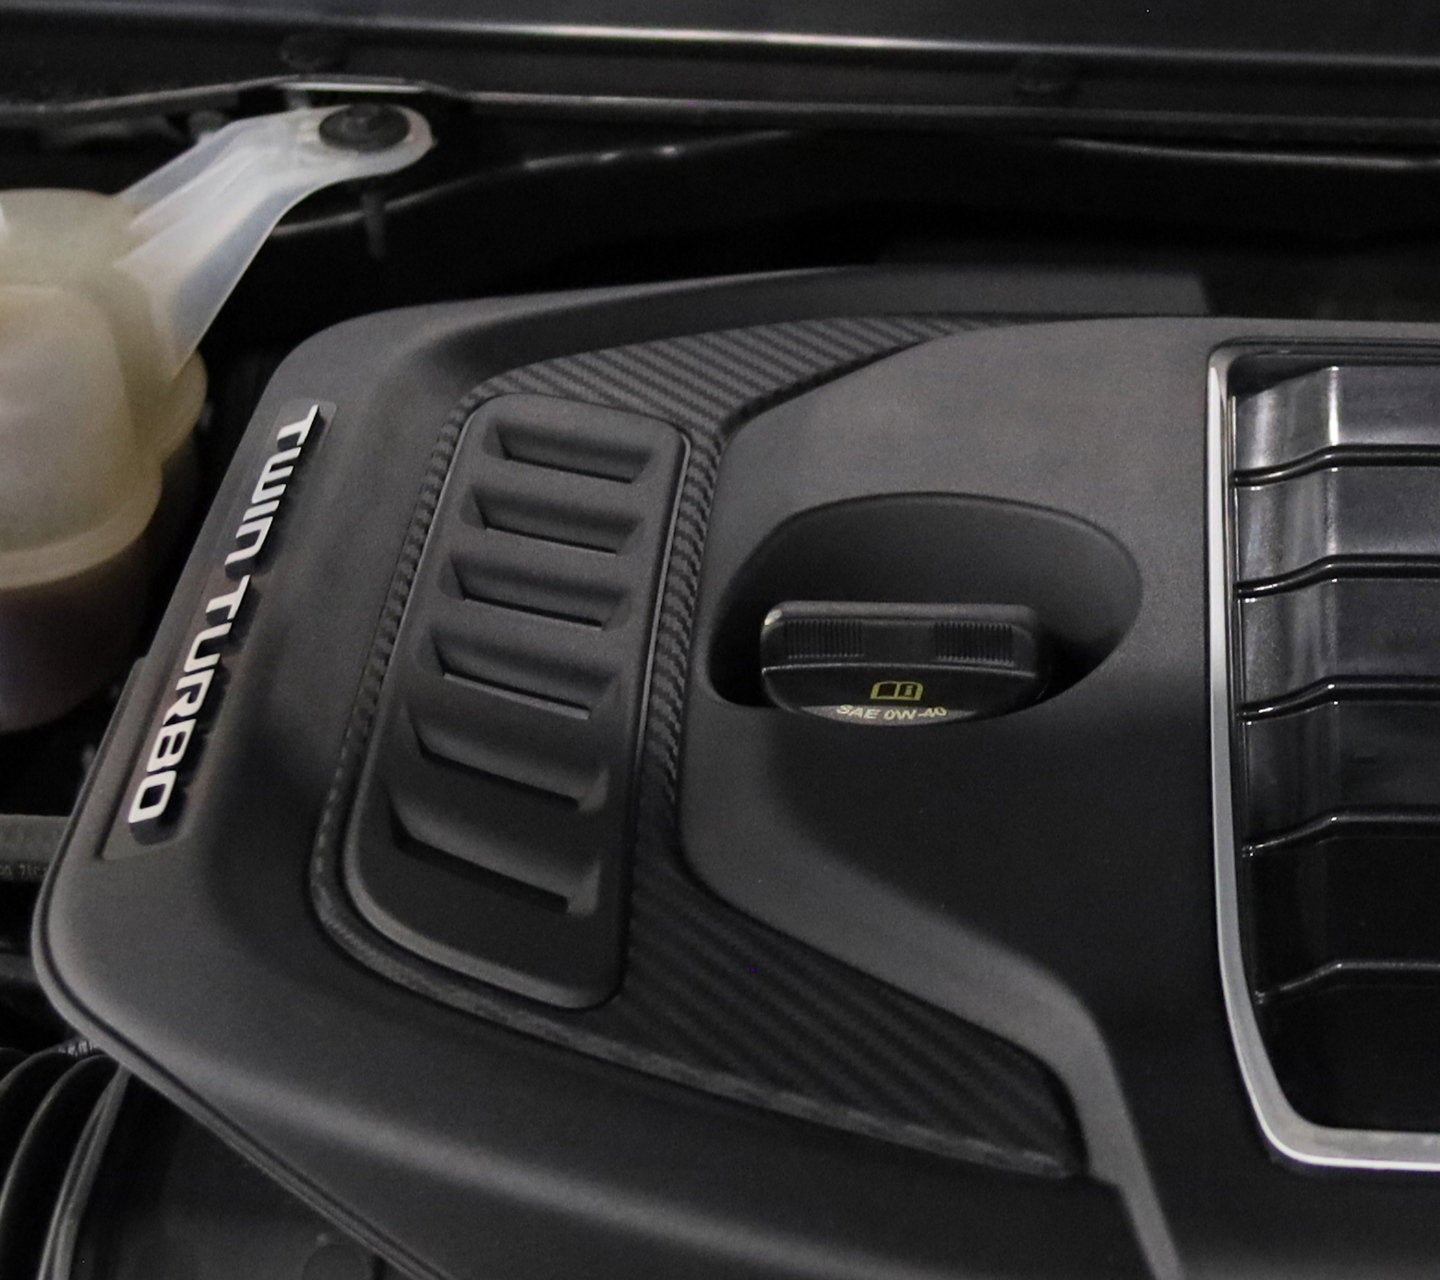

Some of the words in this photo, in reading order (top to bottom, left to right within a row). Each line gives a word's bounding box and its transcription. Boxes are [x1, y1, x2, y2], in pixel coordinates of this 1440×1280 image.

[224, 403, 321, 569] TWIN
[127, 574, 252, 825] TURBO
[836, 703, 881, 720] SAE
